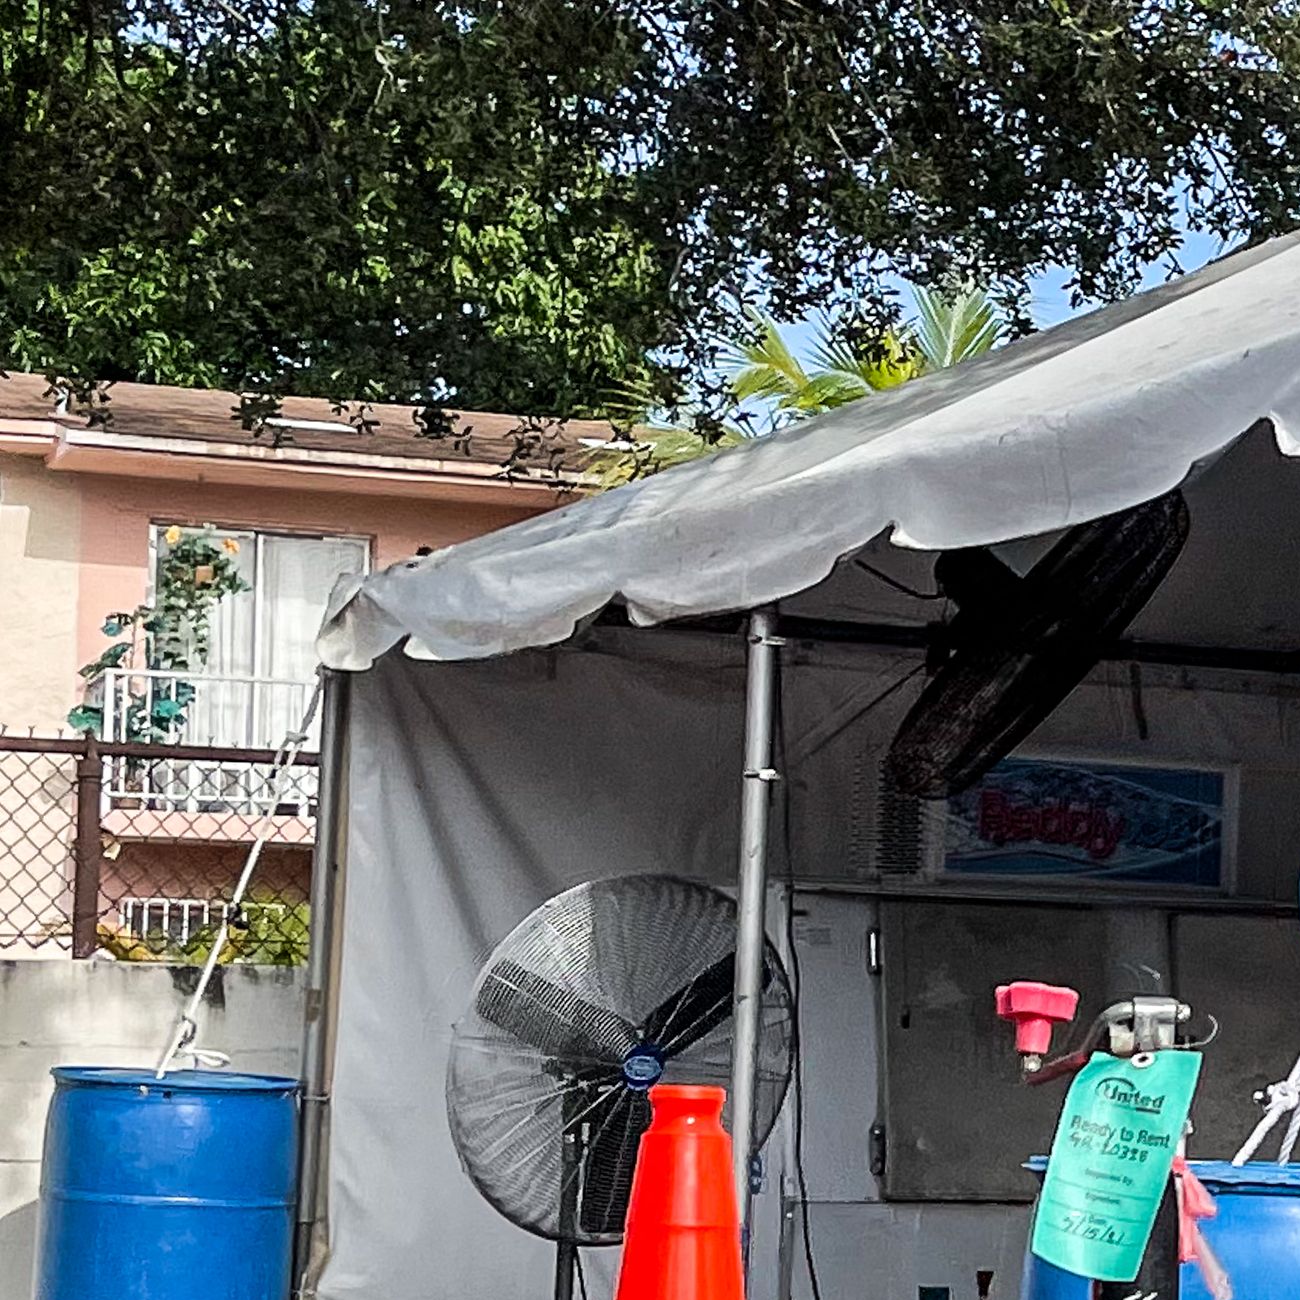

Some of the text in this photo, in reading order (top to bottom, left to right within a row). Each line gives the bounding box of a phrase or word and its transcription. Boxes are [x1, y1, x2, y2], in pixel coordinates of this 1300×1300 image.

[1102, 1081, 1166, 1110] United
[1070, 1114, 1171, 1149] Ready to Rent
